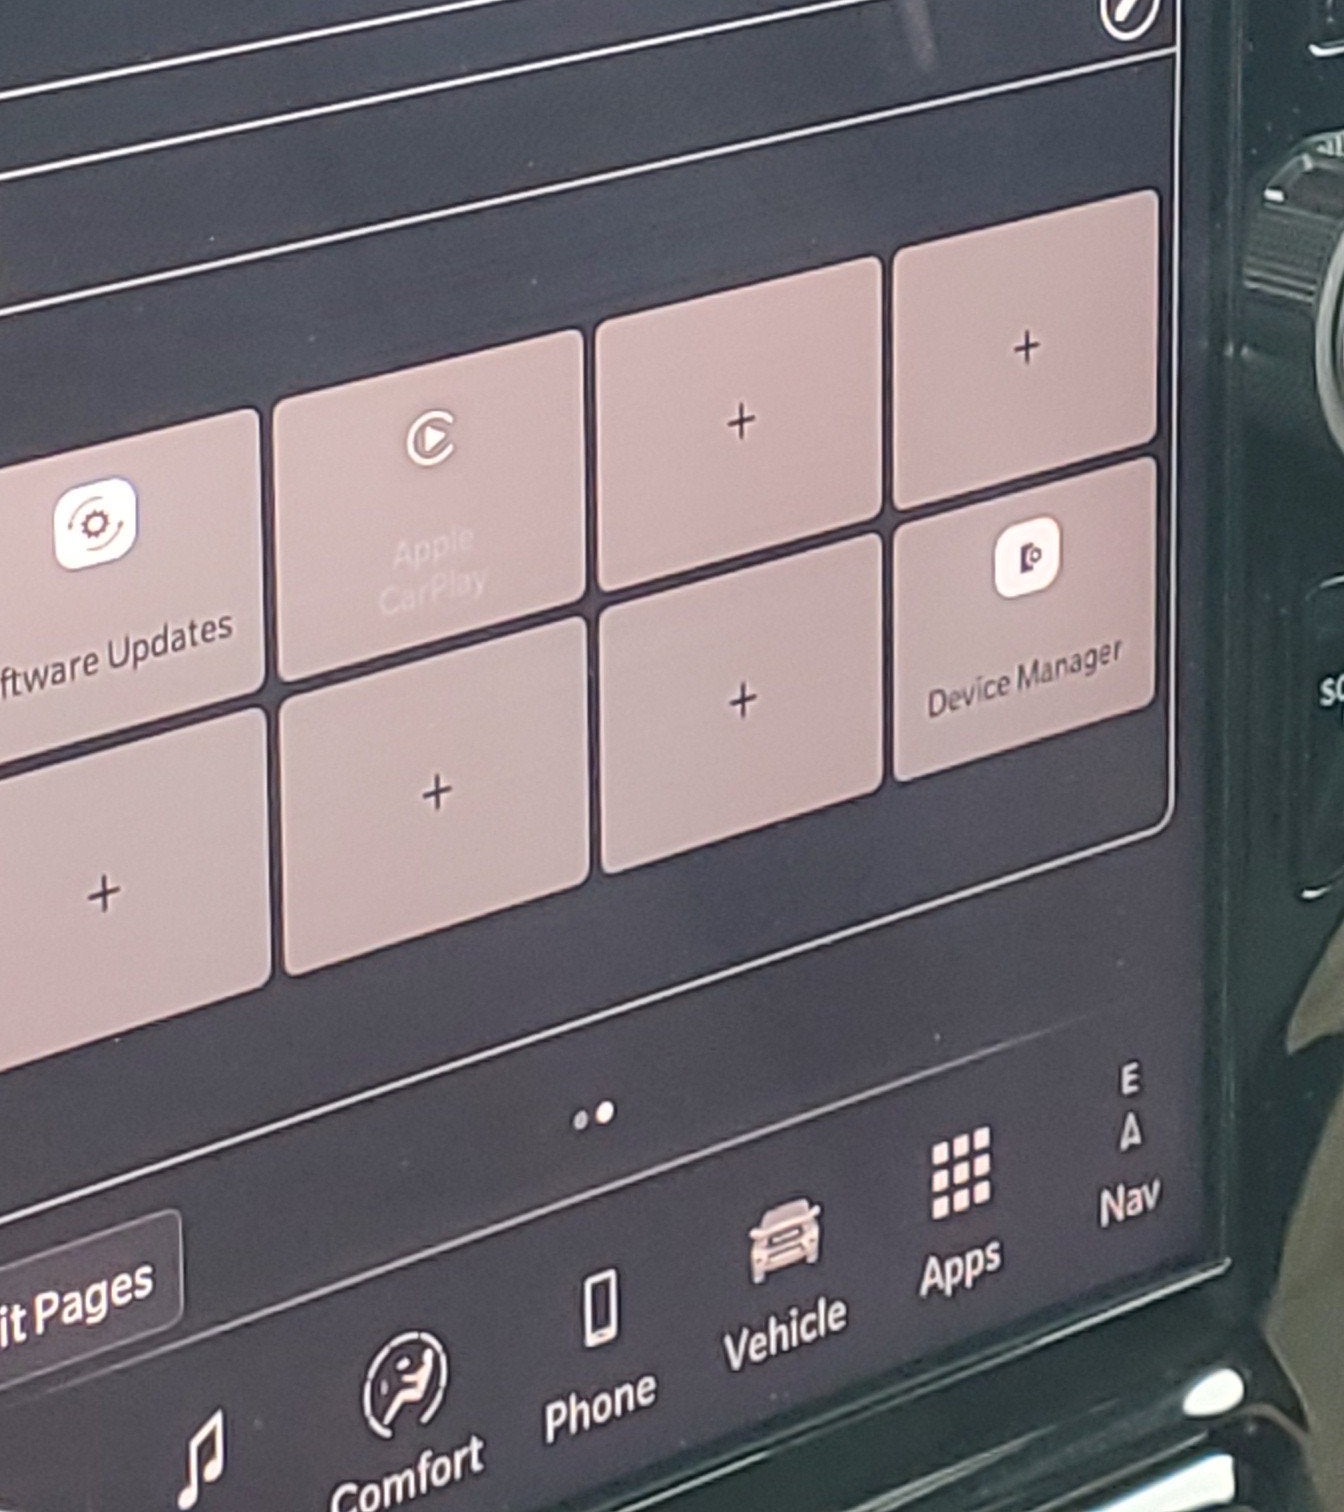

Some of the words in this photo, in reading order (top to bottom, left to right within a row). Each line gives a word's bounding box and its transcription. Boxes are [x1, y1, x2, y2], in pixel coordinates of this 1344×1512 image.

[393, 526, 475, 571] Apple
[107, 614, 234, 671] Updates
[927, 675, 1011, 719] Device
[1016, 639, 1123, 691] Manager
[1121, 1060, 1140, 1096] E
[1119, 1111, 1143, 1152] A
[1100, 1177, 1162, 1229] Nav
[34, 1263, 155, 1336] Pages
[918, 1239, 1004, 1300] Apps
[723, 1295, 849, 1372] Vehicle
[544, 1372, 659, 1446] Phone
[329, 1434, 486, 1512] Comfort
